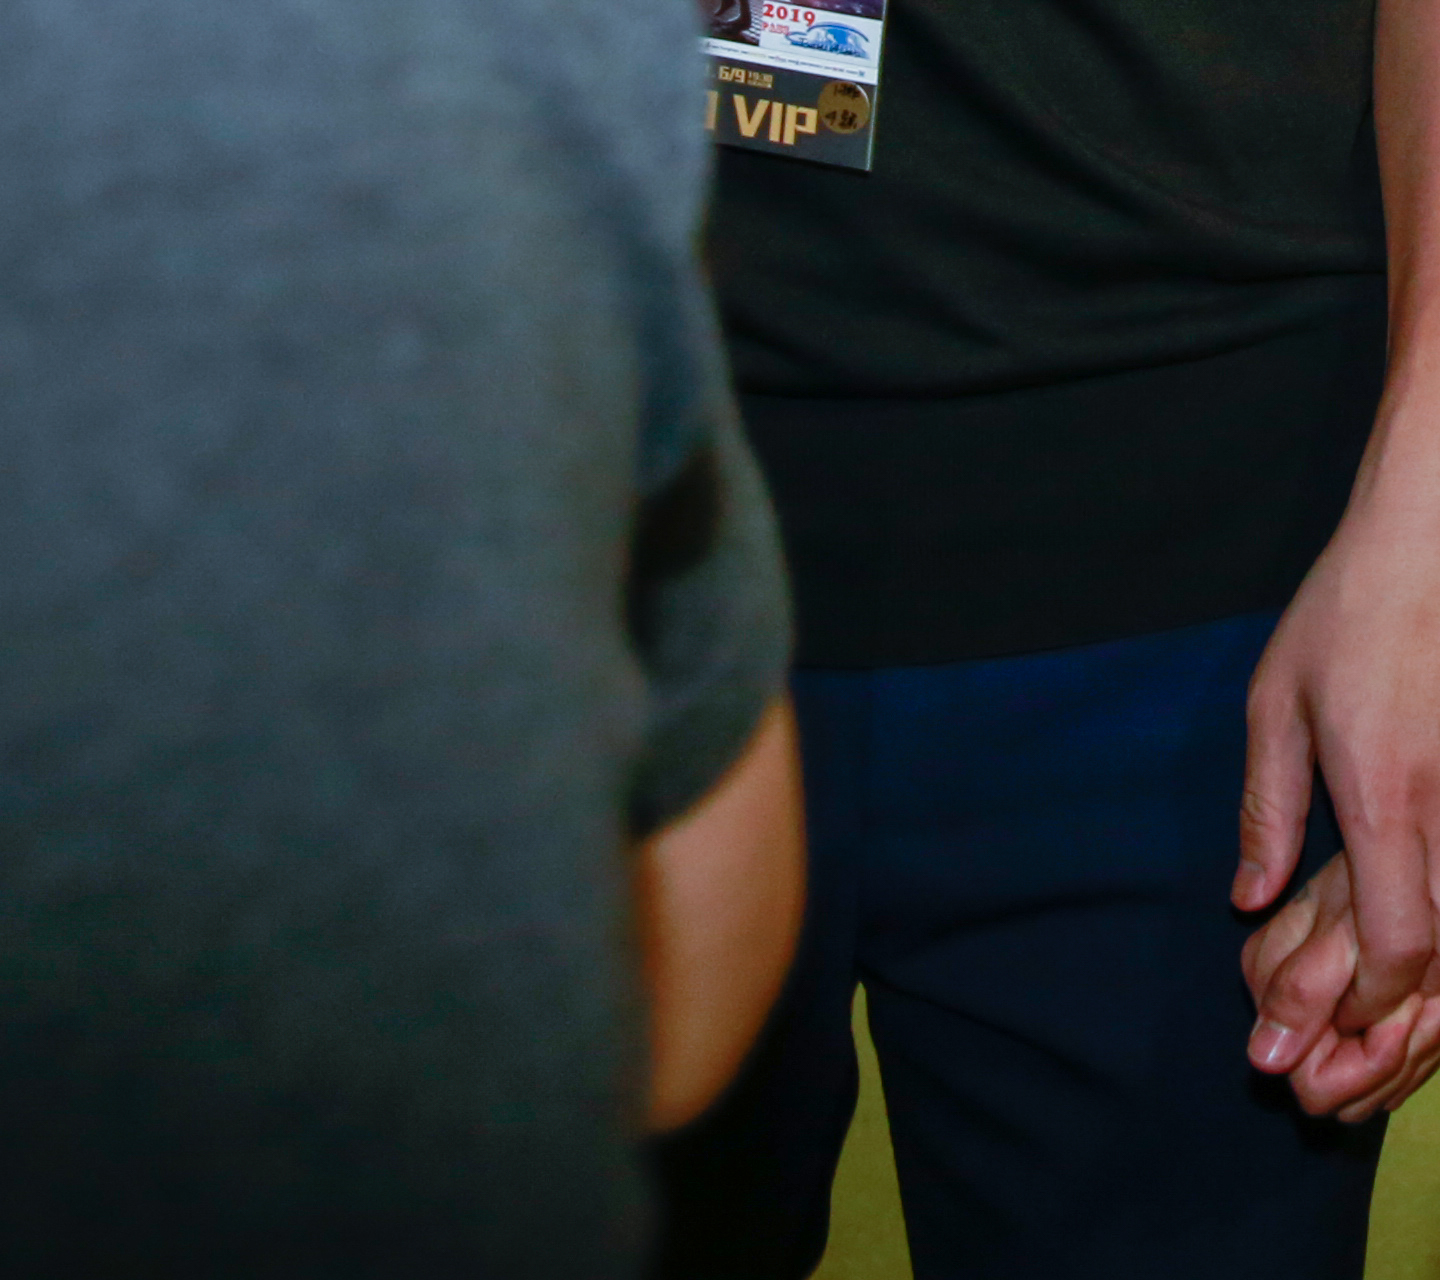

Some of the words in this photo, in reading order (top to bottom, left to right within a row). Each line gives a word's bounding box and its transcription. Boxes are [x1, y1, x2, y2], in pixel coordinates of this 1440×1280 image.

[763, 3, 816, 26] 2019
[718, 65, 747, 84] 6/9
[733, 93, 818, 146] VIP
